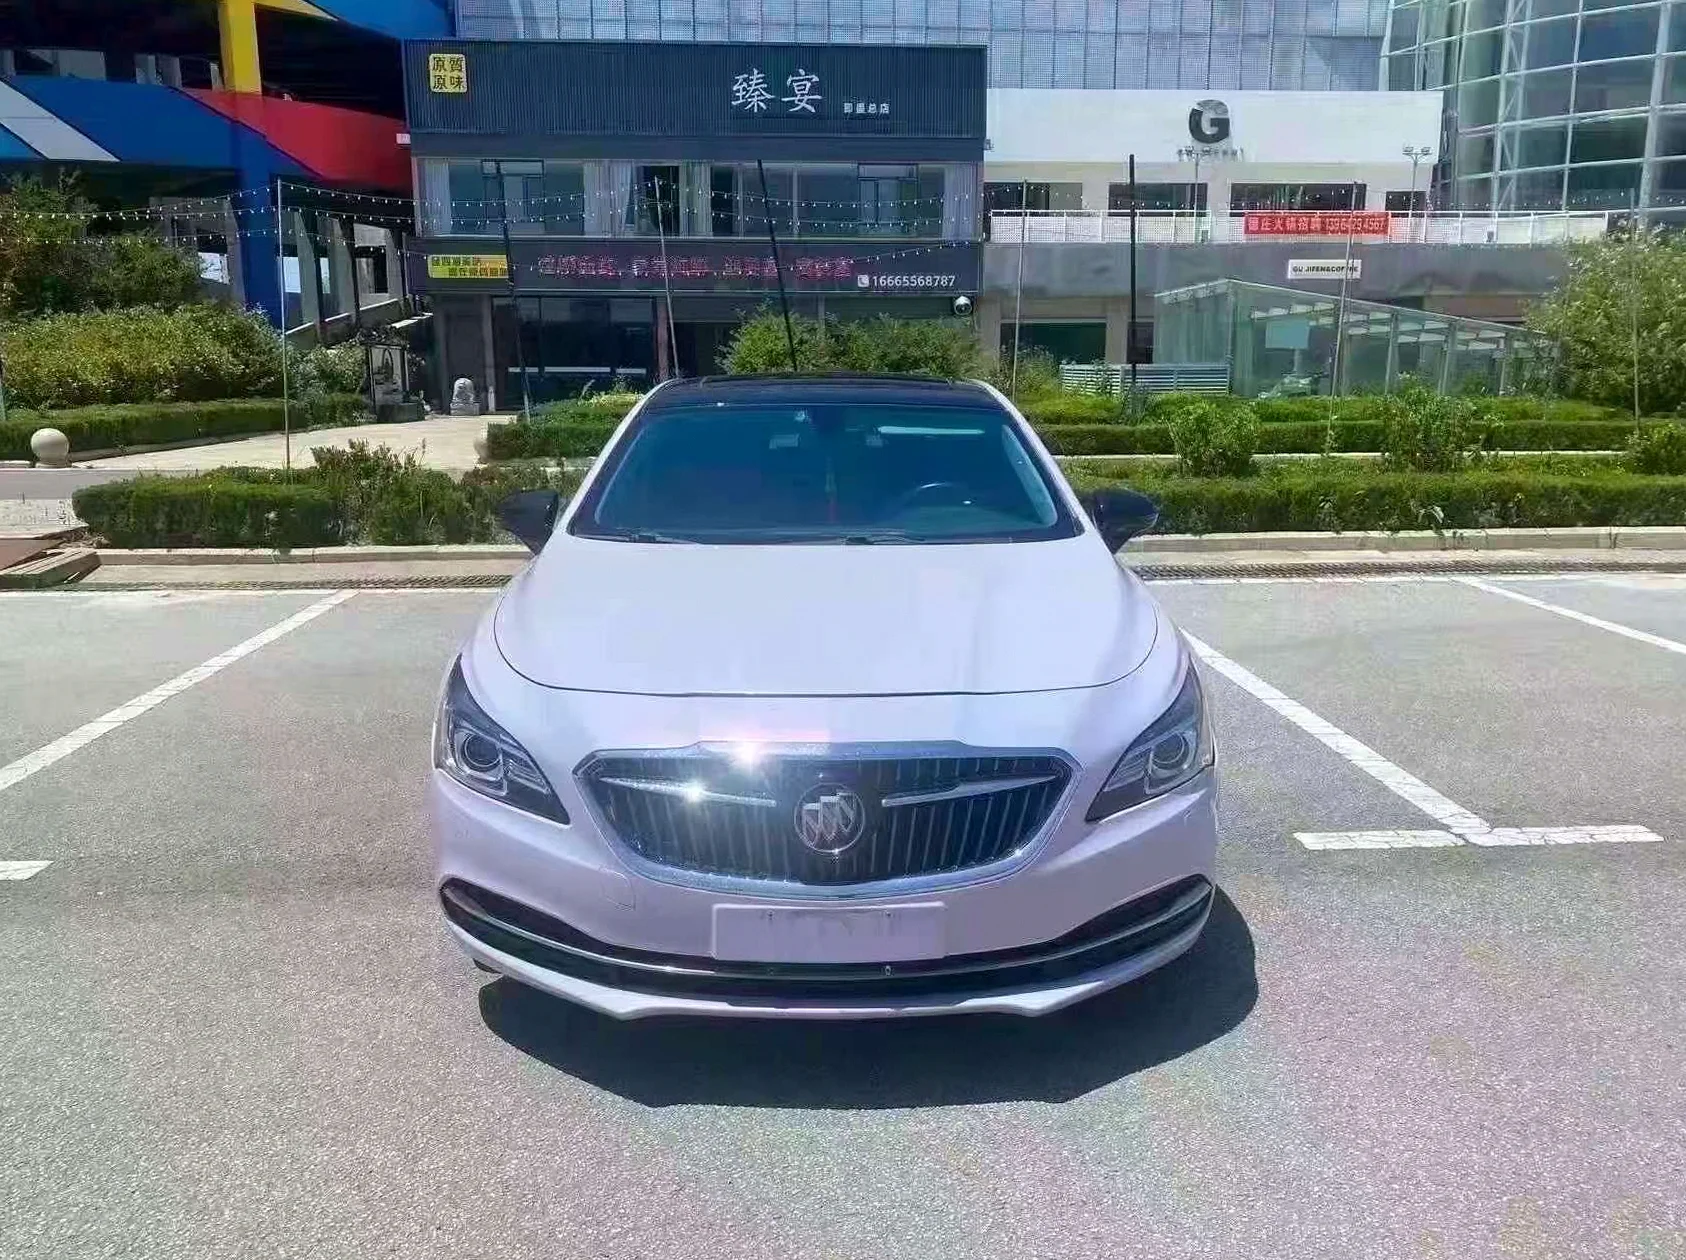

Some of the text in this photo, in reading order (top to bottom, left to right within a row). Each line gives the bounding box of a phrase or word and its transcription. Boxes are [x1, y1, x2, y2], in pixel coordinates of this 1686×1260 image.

[731, 67, 822, 113] 臻宴
[1188, 99, 1230, 144] G
[872, 275, 956, 287] 16665568787
